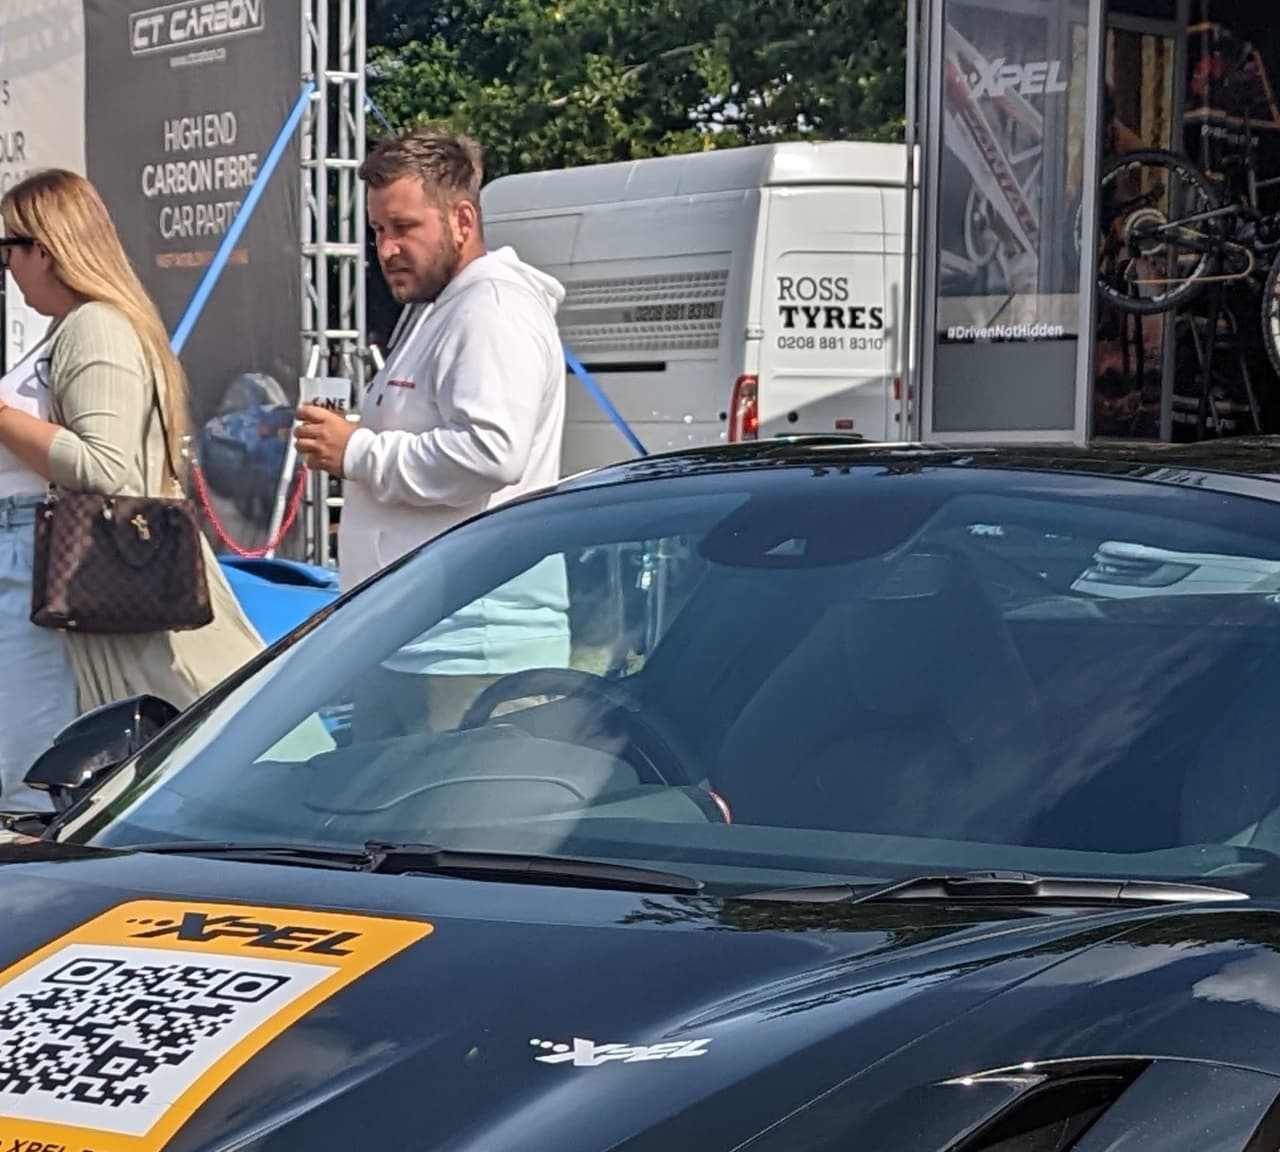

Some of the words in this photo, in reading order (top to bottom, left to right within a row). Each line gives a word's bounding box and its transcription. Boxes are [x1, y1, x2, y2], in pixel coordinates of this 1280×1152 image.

[133, 14, 165, 49] CT
[170, 0, 260, 42] CARBON
[967, 57, 1067, 99] XPEL
[164, 115, 203, 152] HIGH
[204, 111, 237, 148] END
[142, 157, 212, 198] CARBON
[214, 152, 258, 190] FIBRE
[160, 205, 194, 240] CAR
[196, 200, 241, 236] PART
[777, 276, 850, 302] ROSS
[778, 305, 884, 330] TYRES
[947, 323, 1063, 341] #DrivenNotHidden
[777, 335, 816, 350] 0208
[818, 336, 845, 350] 881
[848, 336, 884, 351] 8310
[127, 911, 363, 957] XPEL
[533, 1037, 713, 1067] XPEL
